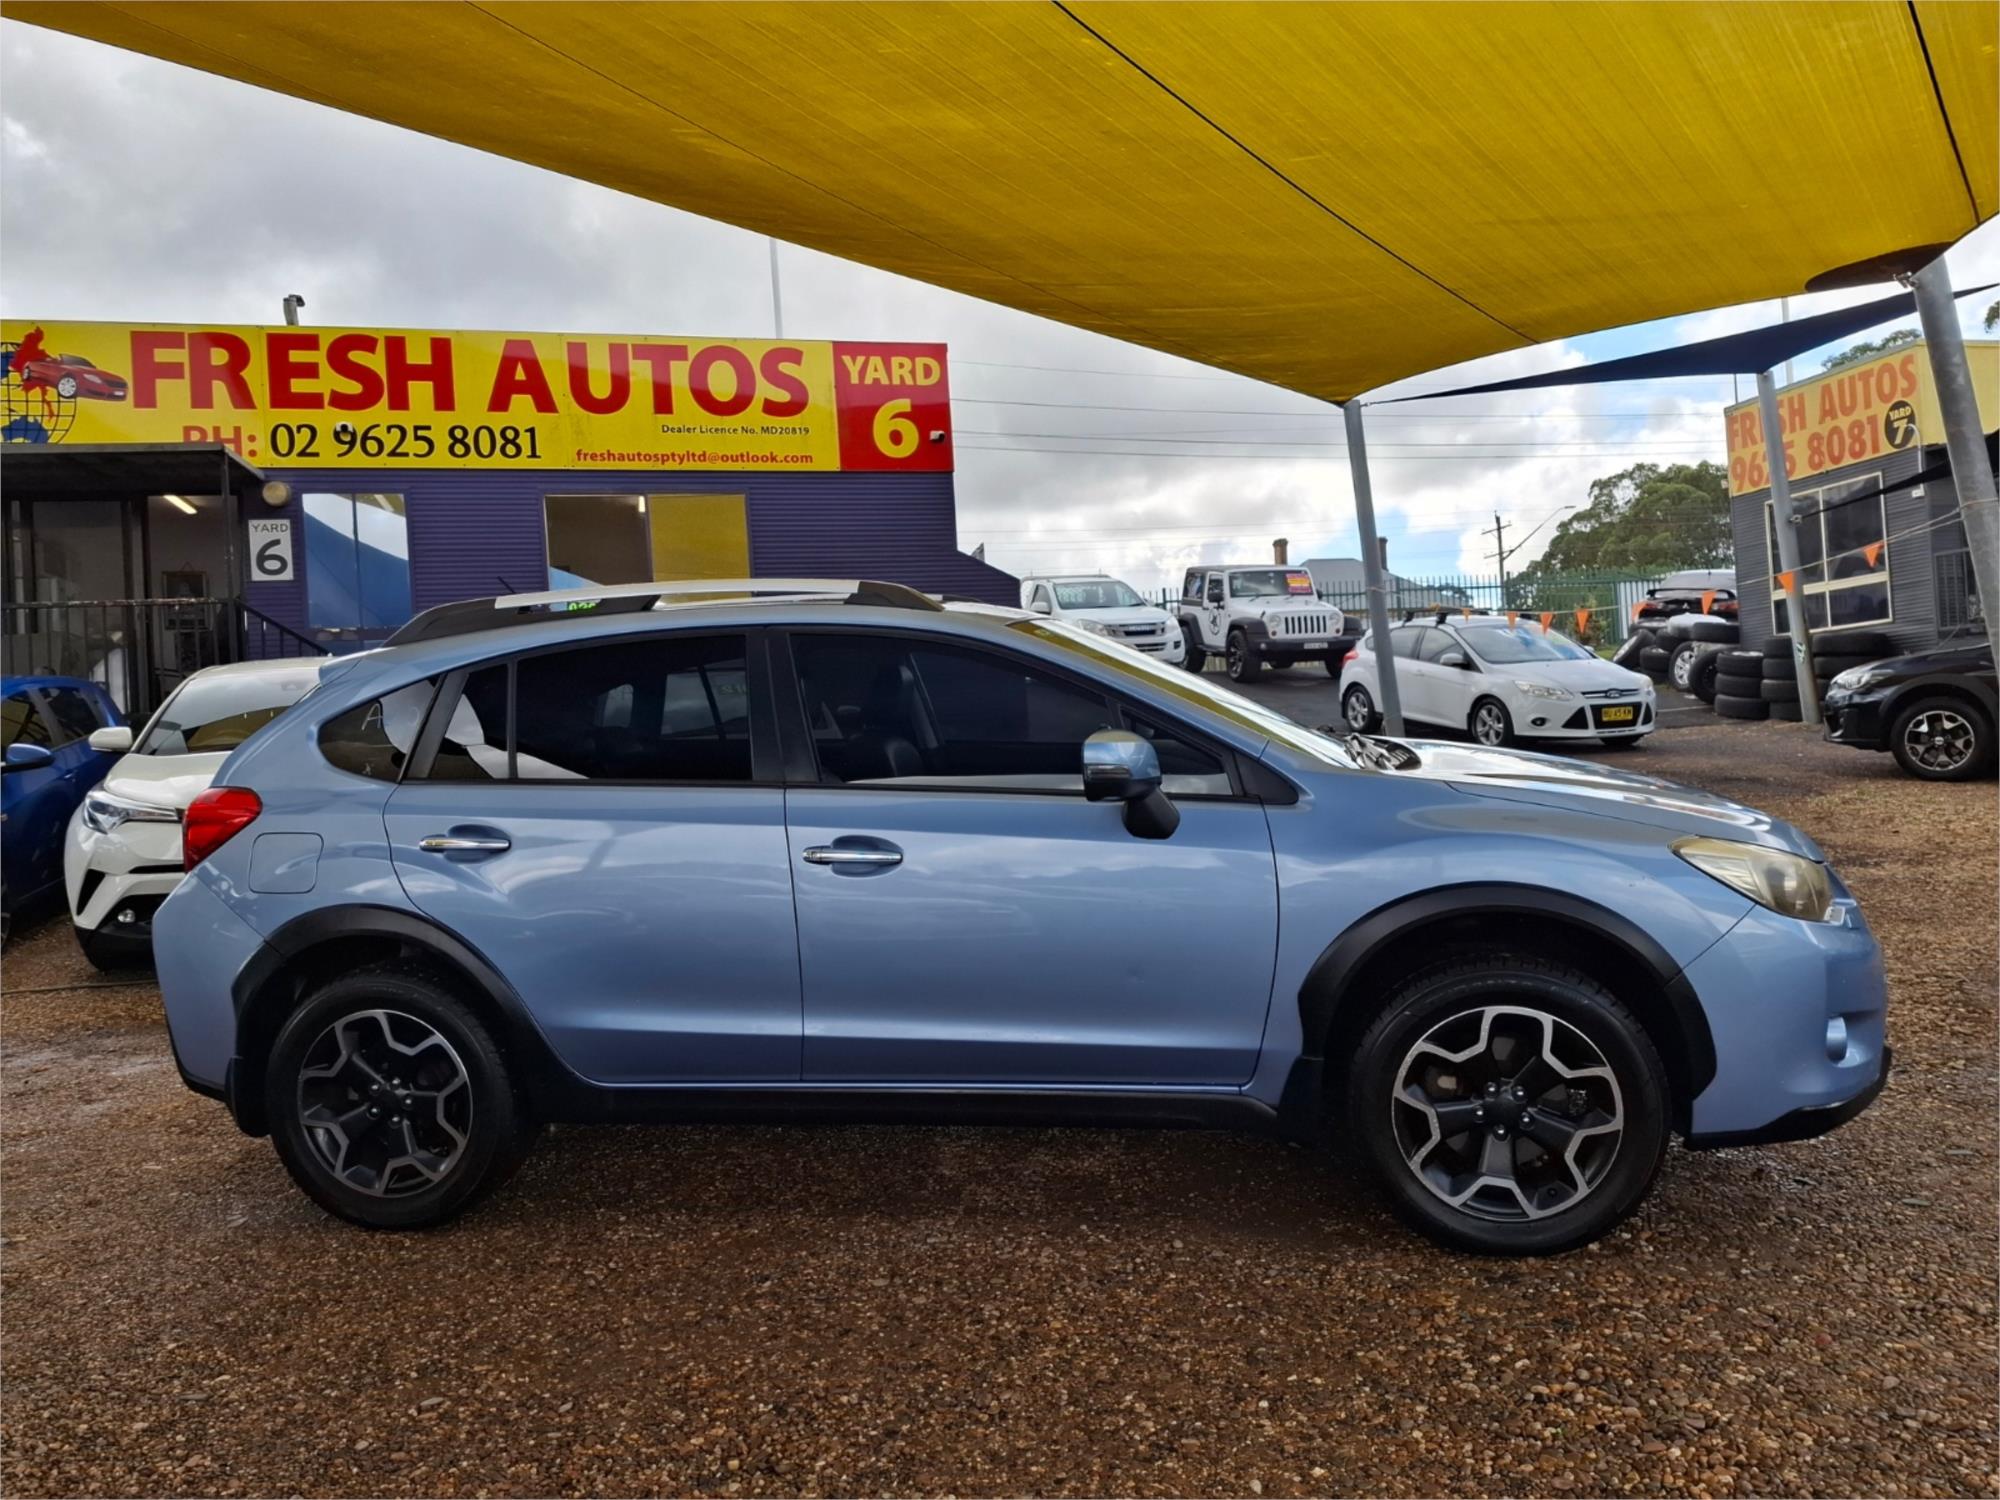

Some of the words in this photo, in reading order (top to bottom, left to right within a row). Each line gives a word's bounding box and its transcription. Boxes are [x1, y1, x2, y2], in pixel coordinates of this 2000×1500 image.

[130, 330, 456, 412] FRESH
[486, 338, 810, 418] AUTOS
[841, 355, 942, 387] YARD
[1818, 353, 1918, 425] AUTOS
[661, 424, 697, 434] Dealer
[699, 424, 739, 435] Licence
[740, 425, 759, 435] No.
[760, 425, 810, 436] MD20819
[871, 397, 920, 459] 6
[1888, 405, 1912, 421] YARD
[270, 422, 321, 458] 02
[332, 422, 436, 459] 9625
[447, 424, 542, 459] 8081
[1806, 414, 1881, 472] 8081
[1892, 418, 1908, 445] 7
[575, 448, 814, 465] freshautosptyltd@outlook.com
[251, 523, 289, 533] YARD
[255, 538, 289, 576] 6
